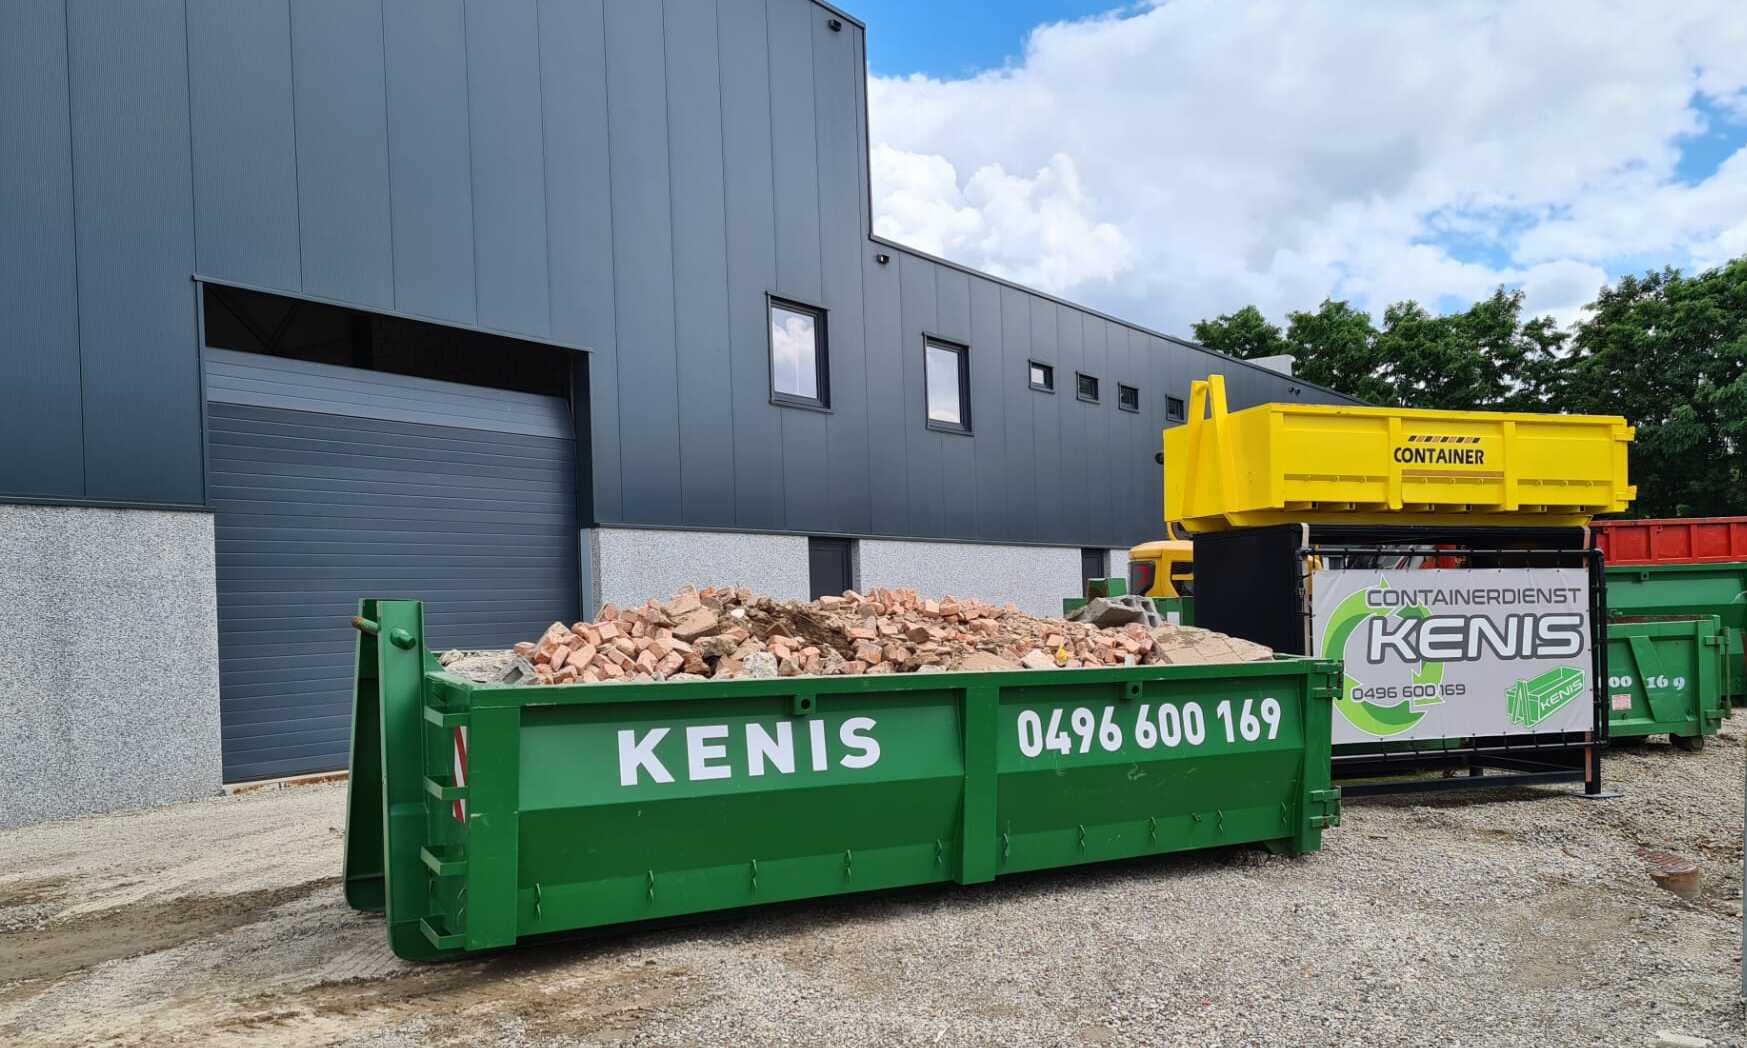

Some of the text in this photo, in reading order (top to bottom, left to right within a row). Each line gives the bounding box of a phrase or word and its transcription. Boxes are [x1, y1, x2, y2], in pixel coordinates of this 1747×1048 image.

[1393, 447, 1485, 465] CONTAINER
[1367, 587, 1582, 608] CONTAINERDIENST
[1367, 613, 1585, 665] KENIS
[1352, 684, 1466, 701] 0496 600 169
[1540, 679, 1583, 710] KENIS
[1017, 697, 1281, 758] 0496 600 169
[617, 716, 881, 786] KENIS
